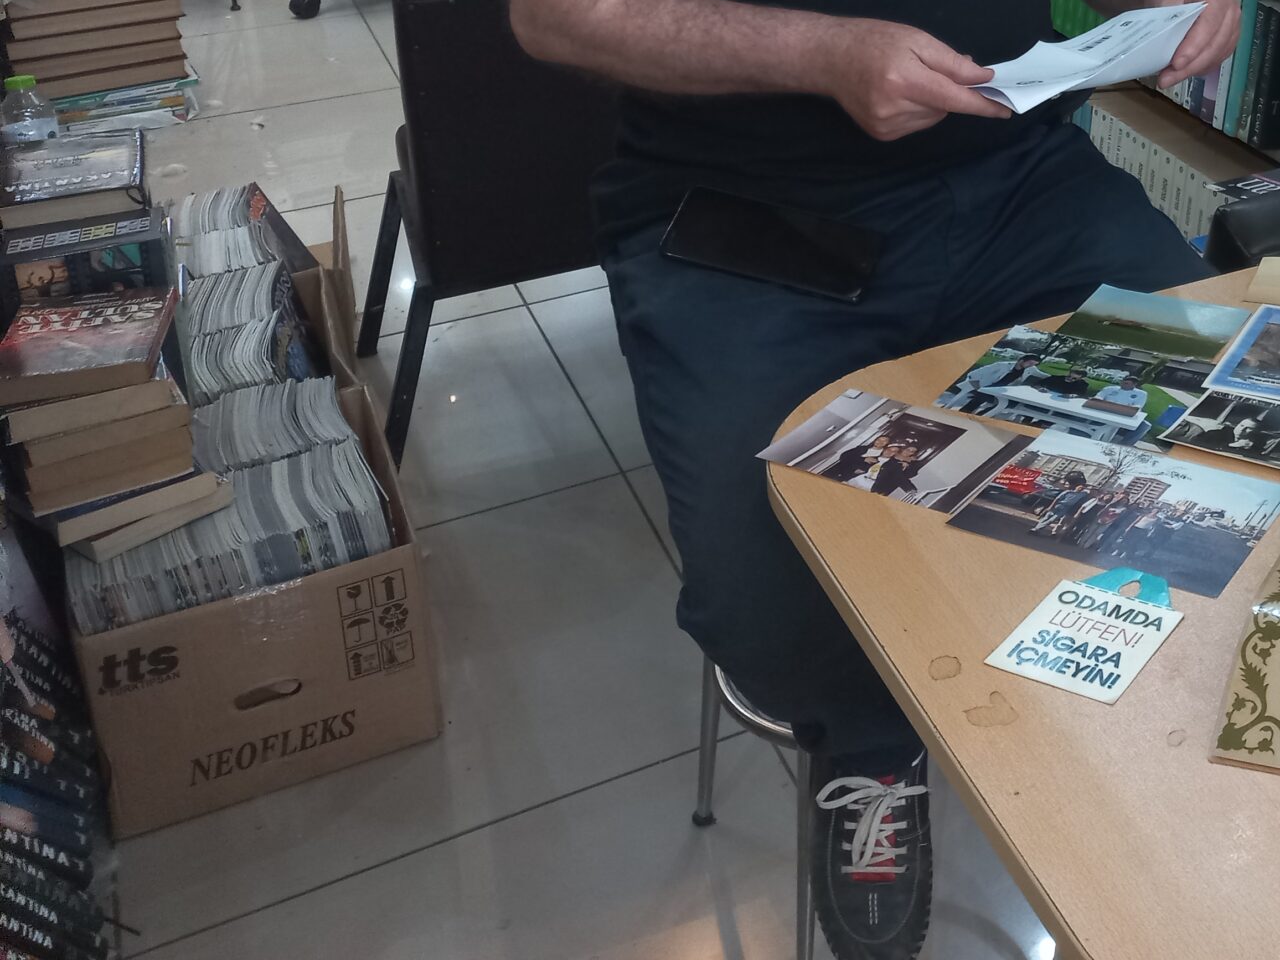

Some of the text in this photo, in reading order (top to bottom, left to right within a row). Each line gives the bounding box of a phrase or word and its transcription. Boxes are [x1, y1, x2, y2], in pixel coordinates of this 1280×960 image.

[1049, 609, 1145, 649] LÜTFEN!
[1058, 589, 1165, 633] ODAMDA
[98, 645, 181, 691] tts
[1006, 639, 1122, 690] İÇMEYİN!
[1032, 627, 1123, 670] SİGARA
[189, 708, 357, 787] NEOFLEKS
